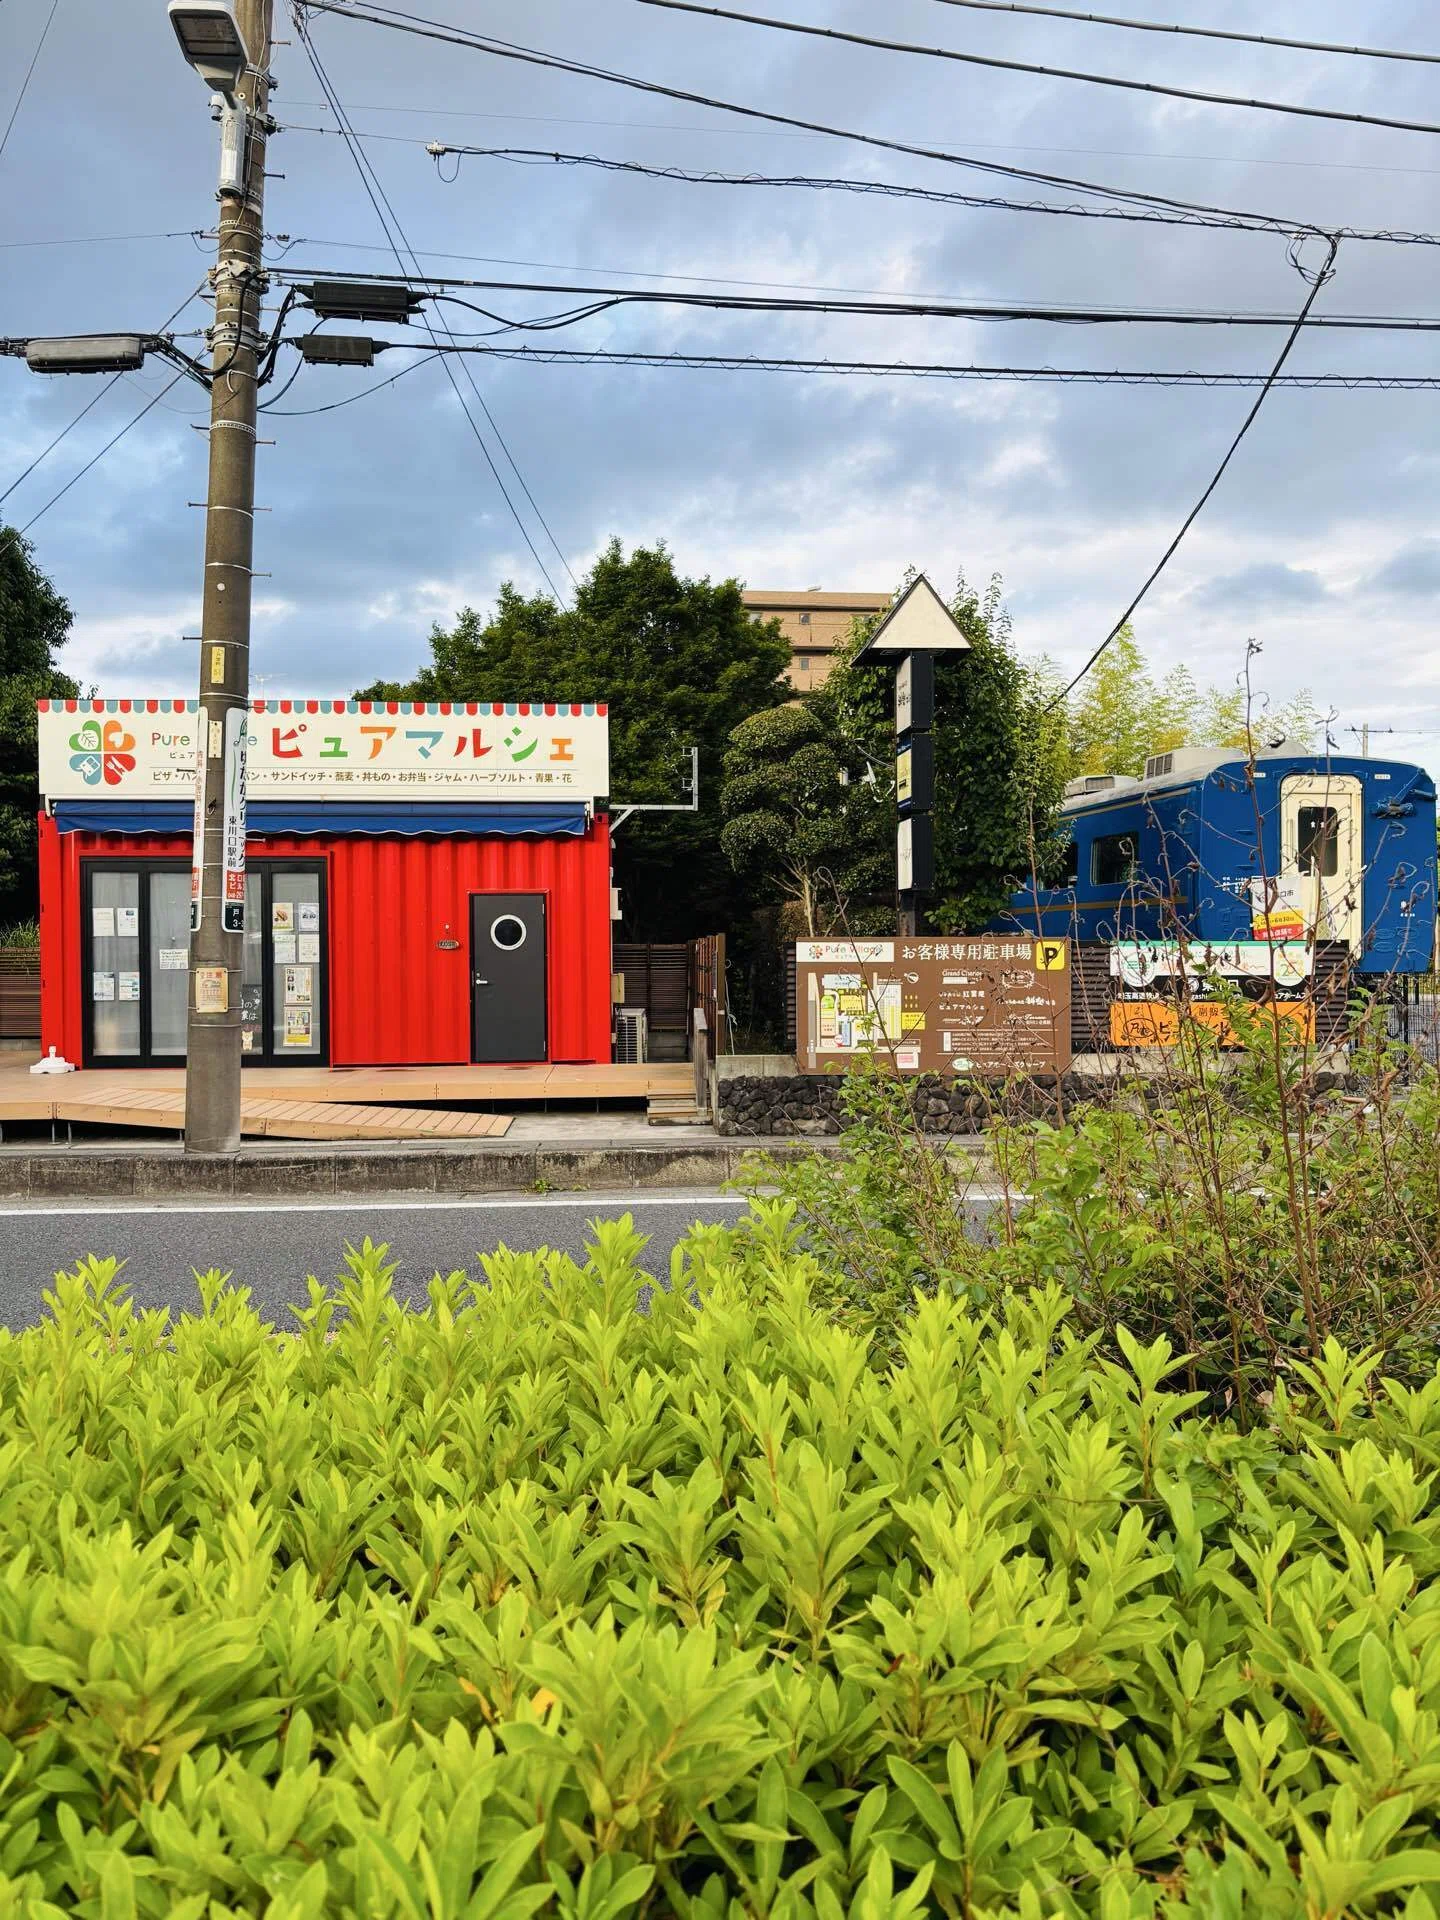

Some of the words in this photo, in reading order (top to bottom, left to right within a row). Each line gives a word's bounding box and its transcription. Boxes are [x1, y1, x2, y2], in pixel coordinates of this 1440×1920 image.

[152, 732, 191, 746] Pure
[272, 724, 574, 762] ピュアマルシェ
[227, 815, 237, 867] 東川口駅前
[902, 944, 1032, 961] お客様専用駐車場
[1044, 947, 1058, 965] P
